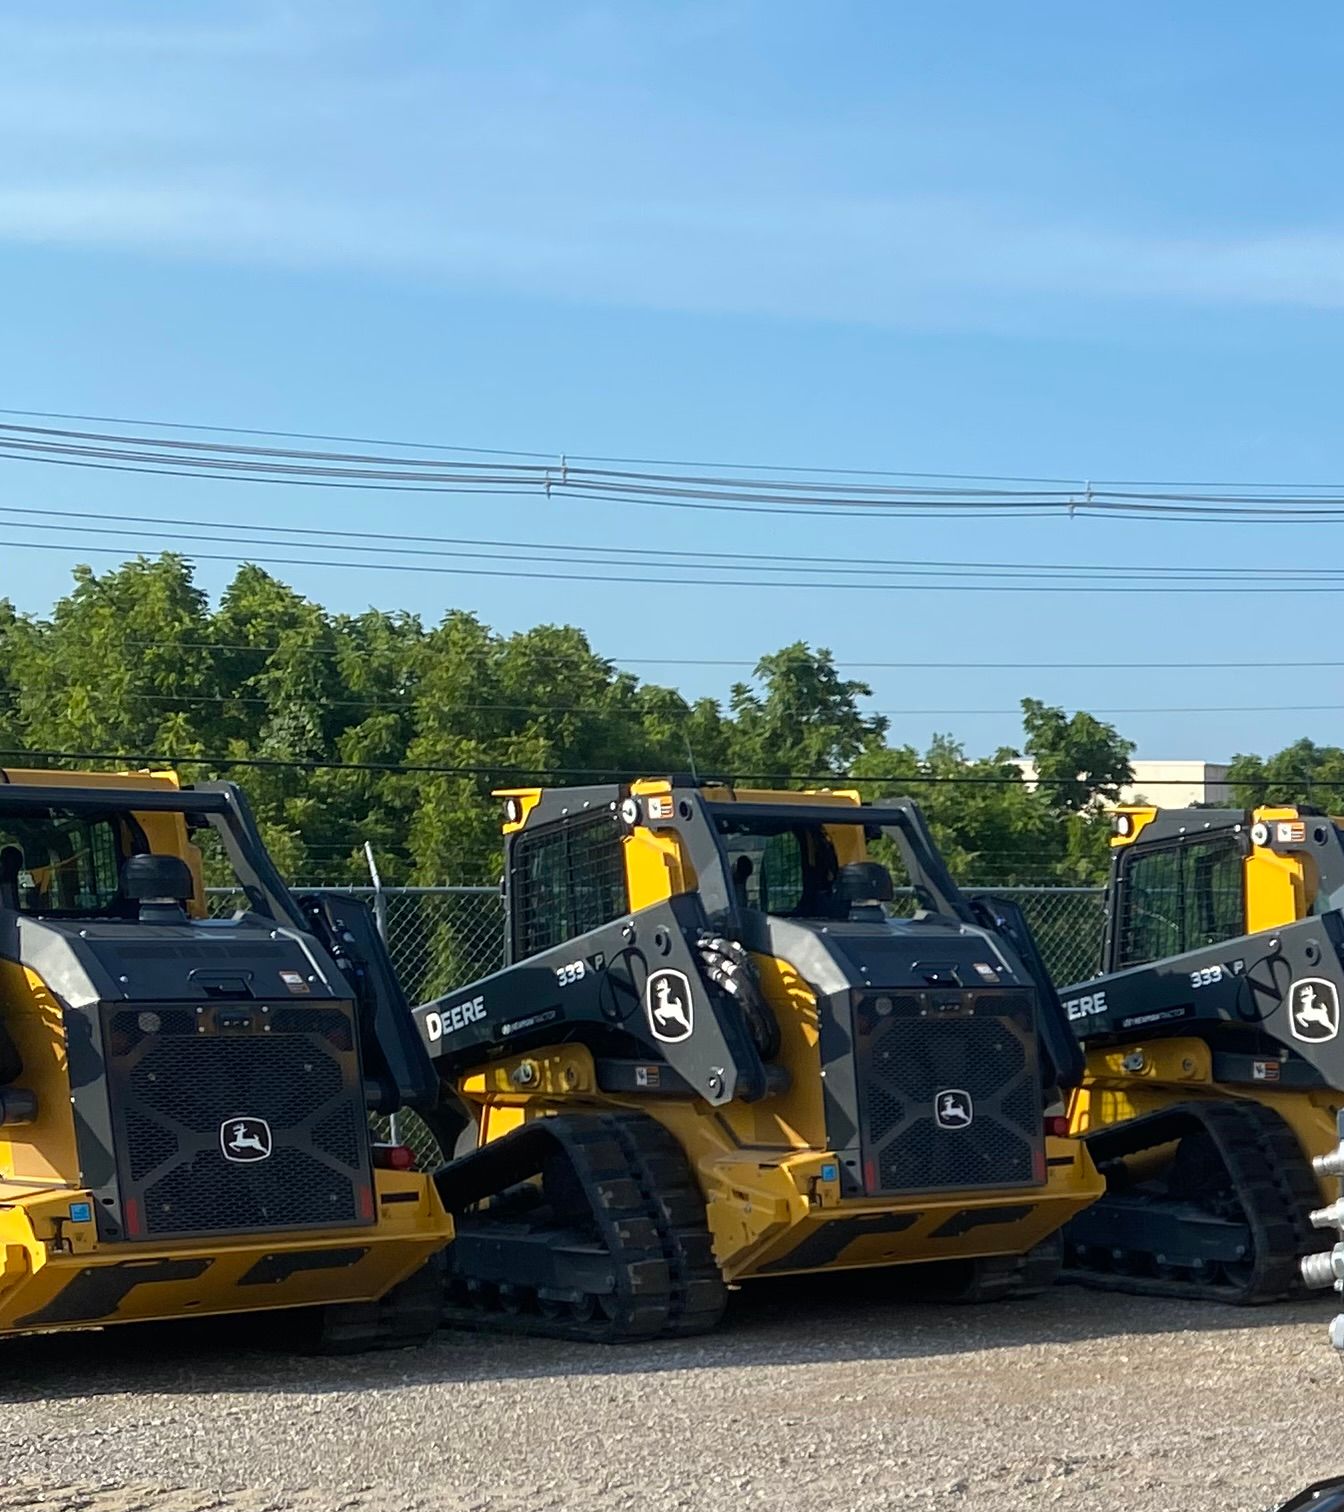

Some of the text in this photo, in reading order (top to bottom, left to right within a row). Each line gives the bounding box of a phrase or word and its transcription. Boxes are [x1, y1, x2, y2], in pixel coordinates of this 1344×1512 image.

[556, 960, 585, 987] 333
[1190, 965, 1223, 989] 333
[426, 995, 487, 1041] DEERE
[1062, 991, 1108, 1020] ERE
